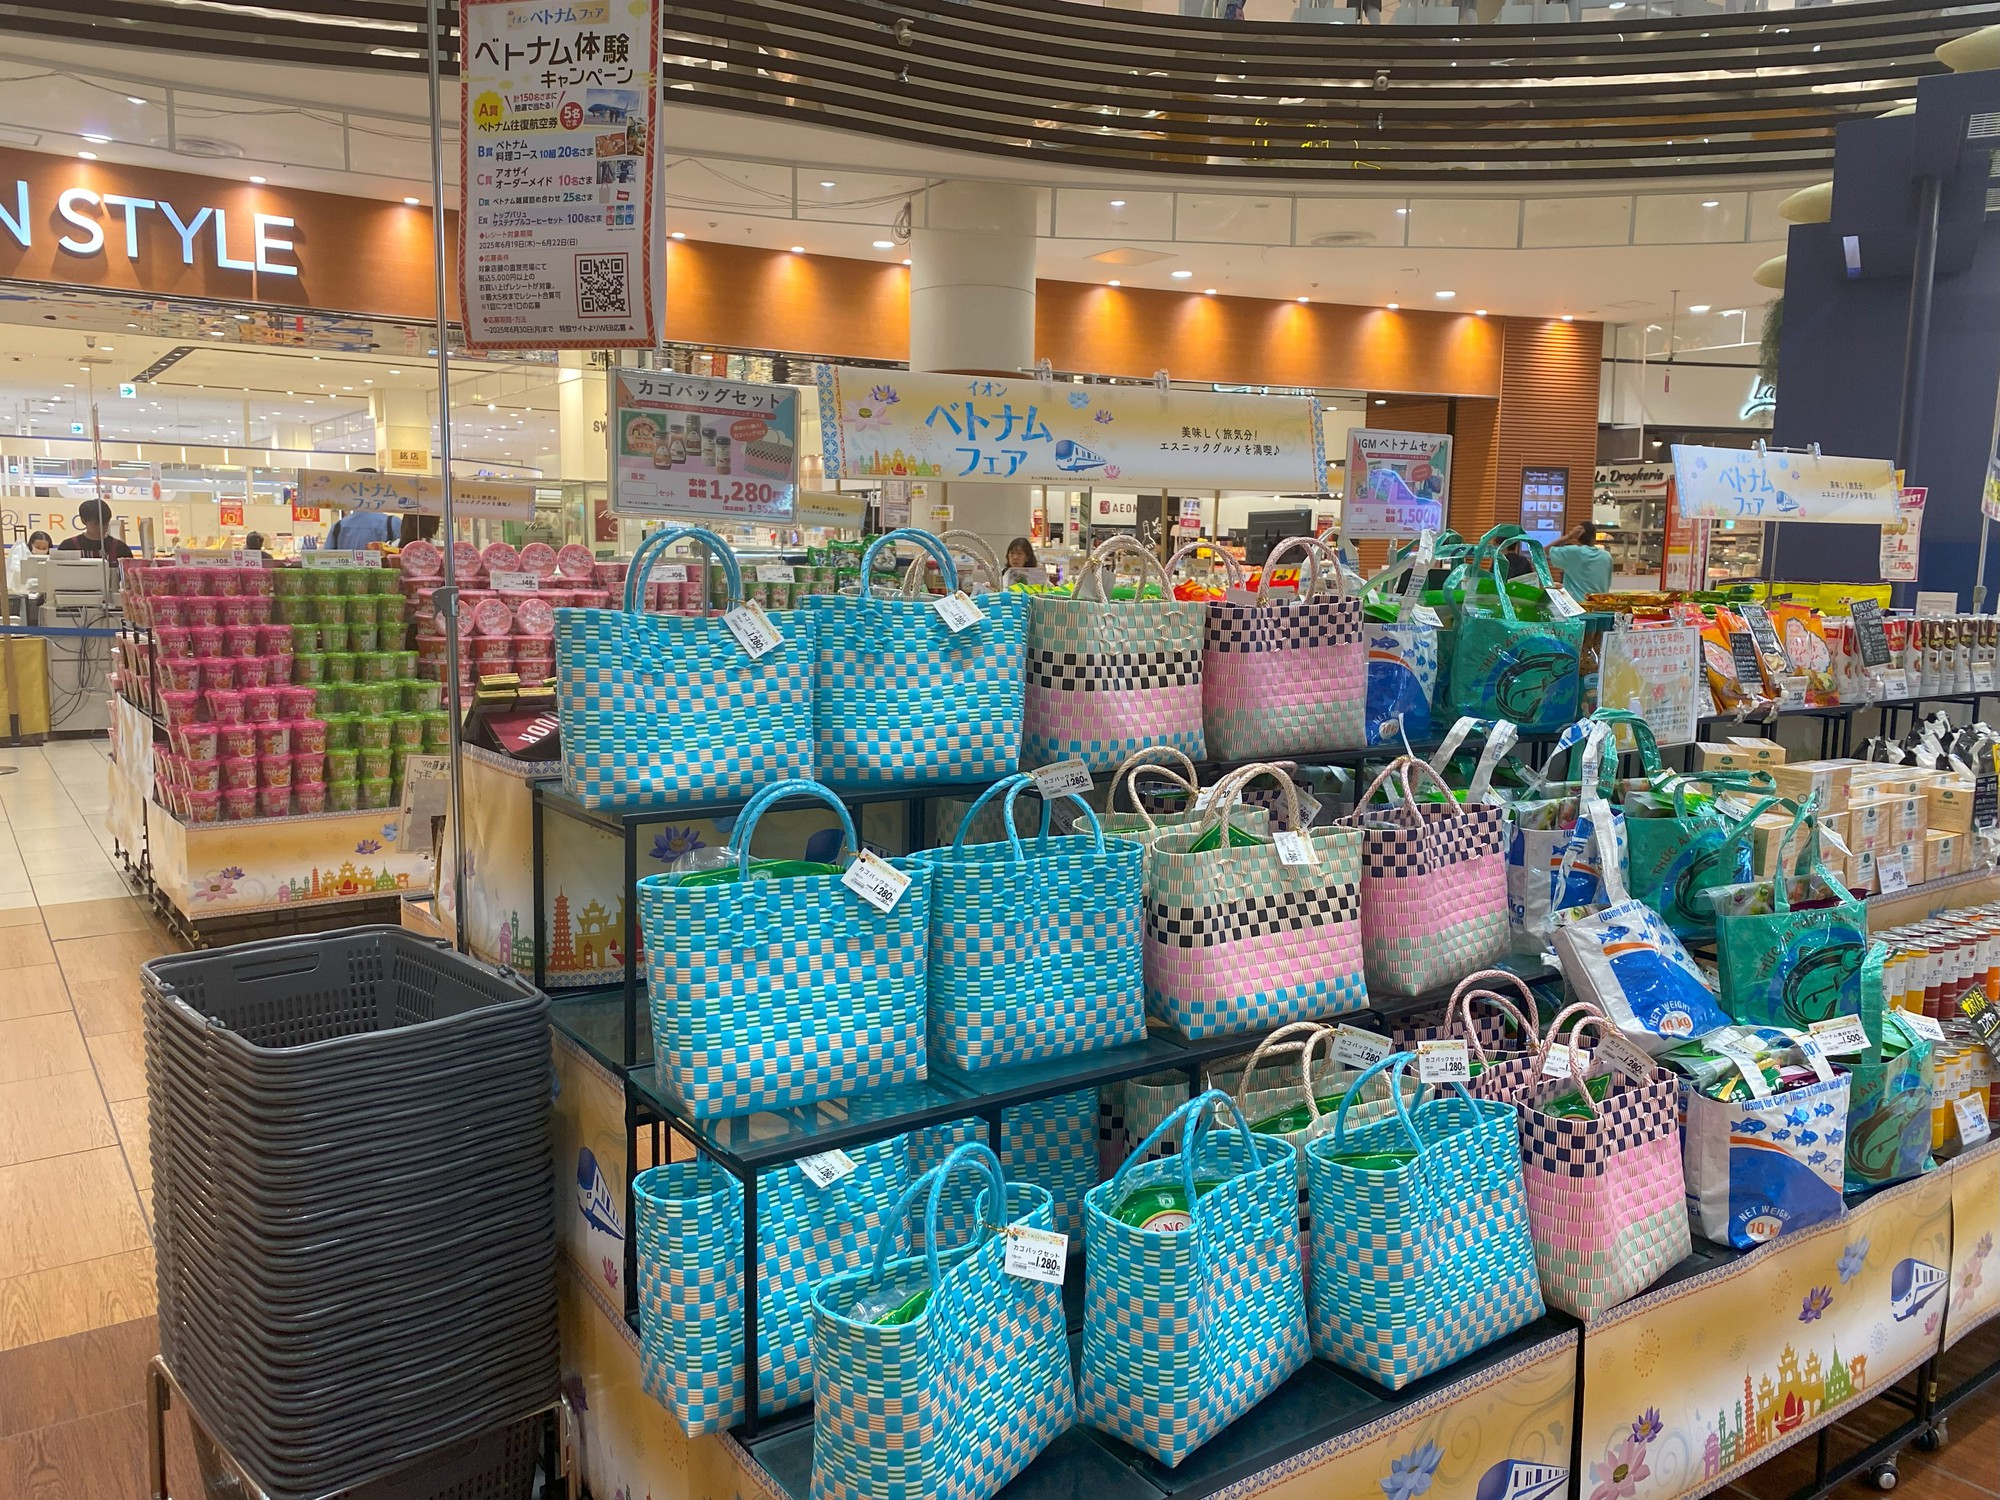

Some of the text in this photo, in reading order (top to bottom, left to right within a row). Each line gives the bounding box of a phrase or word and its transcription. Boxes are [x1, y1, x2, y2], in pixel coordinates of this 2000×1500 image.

[475, 31, 630, 71] ベトナム体験
[541, 67, 633, 88] キャンペーン
[478, 103, 498, 117] A賞
[564, 105, 581, 120] 5名
[478, 117, 558, 132] ベトナム往復航空券
[478, 146, 493, 158] B賞
[496, 140, 528, 149] ベトナム
[496, 151, 538, 162] 料理コース
[558, 146, 594, 158] 20名さま
[496, 166, 529, 179] アオザイ
[476, 175, 493, 186] C賞
[496, 175, 593, 189] オーダーメイド 10名さま
[493, 211, 527, 219] トップバリュ
[57, 187, 298, 276] STYLE
[638, 379, 780, 410] カゴバッグセット
[968, 380, 1008, 398] イオン
[925, 400, 1054, 443] ベトナム
[1380, 438, 1444, 452] ベトナムセット
[956, 448, 1028, 478] フェア
[1719, 468, 1775, 494] ベトナム
[341, 480, 398, 498] ベトナム
[353, 497, 386, 510] フェア
[1735, 496, 1764, 516] フェア
[1661, 1000, 1691, 1013] WEIGHT
[1660, 1016, 1692, 1032] 10 kg
[1739, 1205, 1791, 1222] NET WEIGHT
[1750, 1222, 1765, 1234] 10
